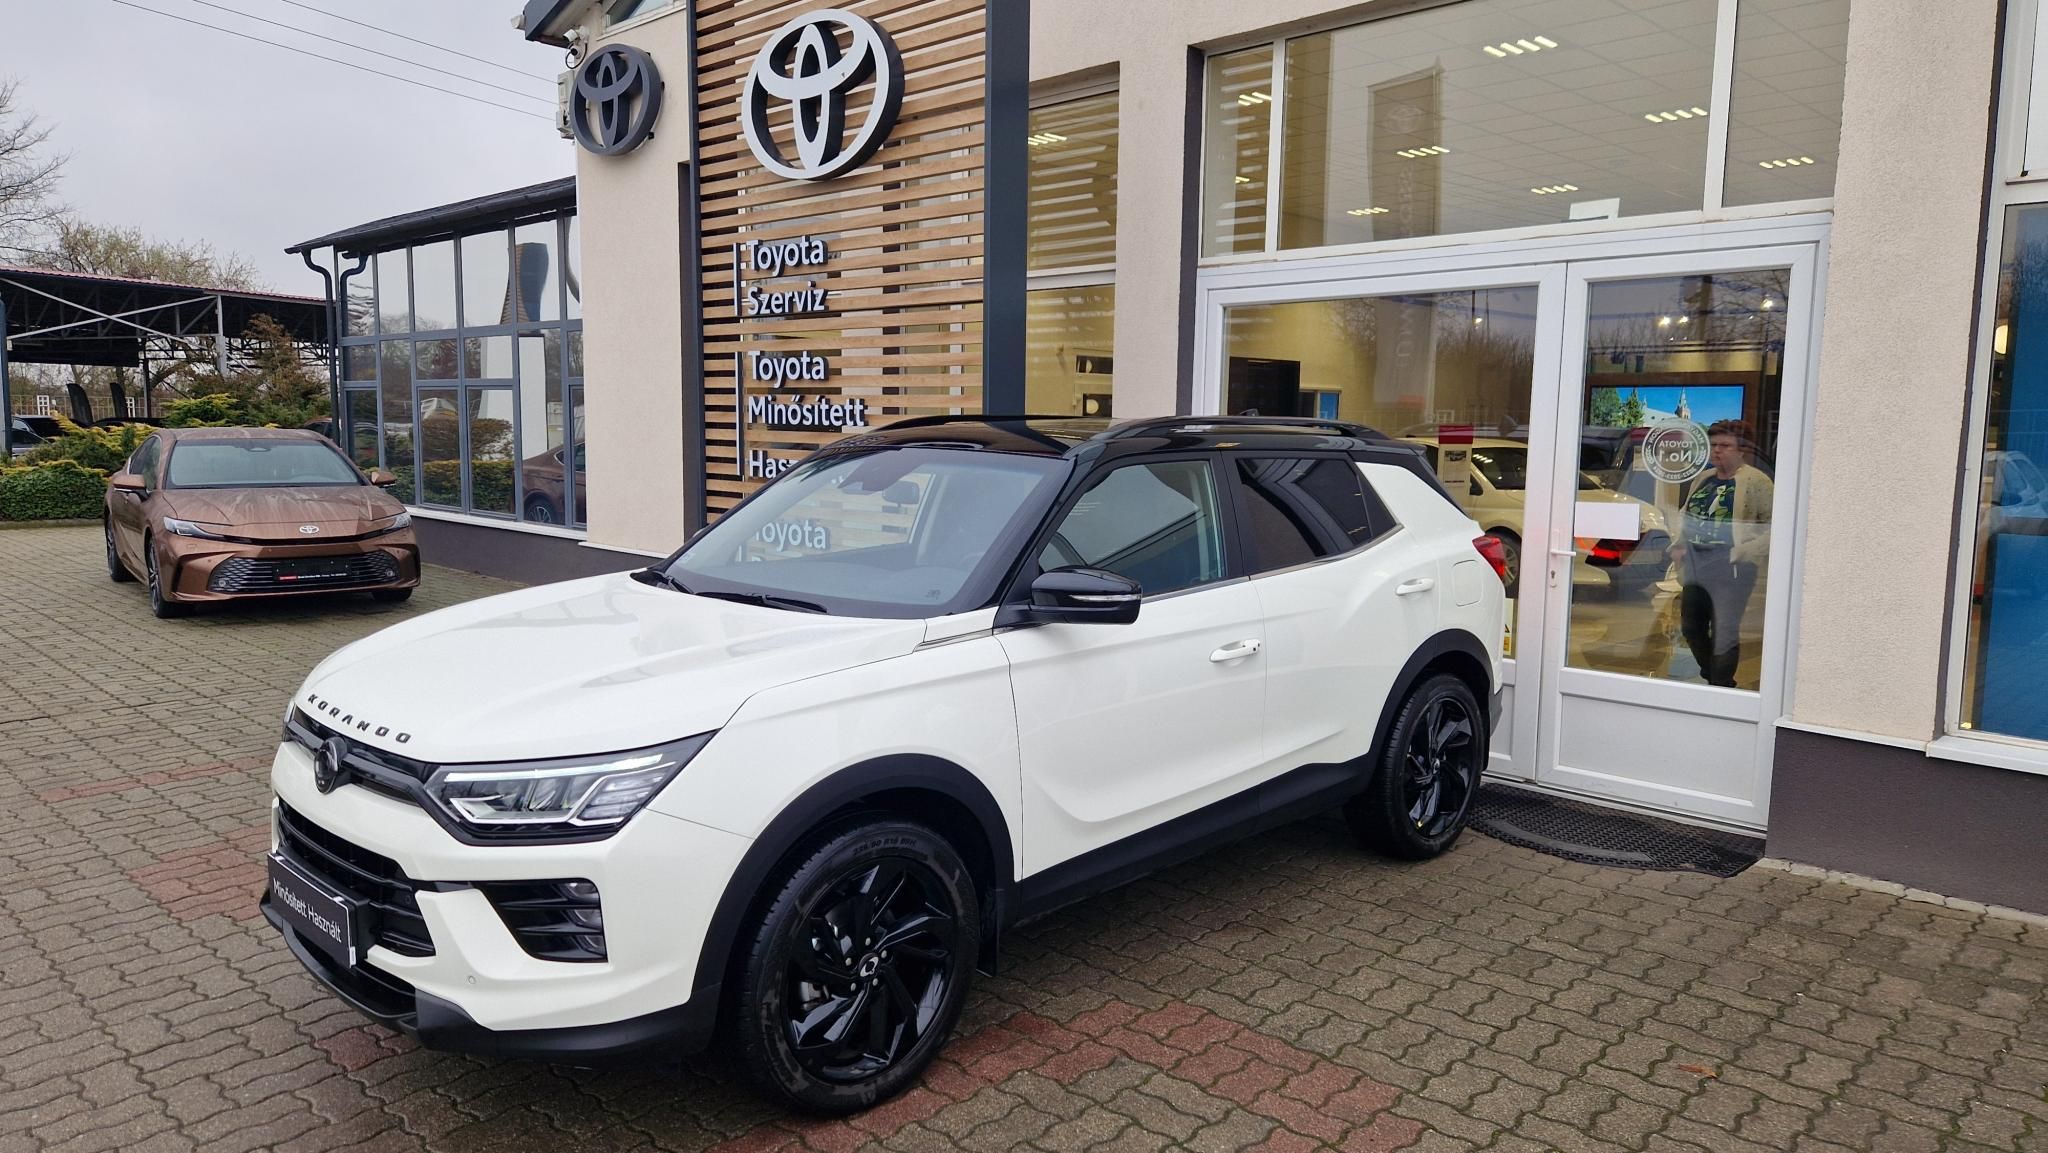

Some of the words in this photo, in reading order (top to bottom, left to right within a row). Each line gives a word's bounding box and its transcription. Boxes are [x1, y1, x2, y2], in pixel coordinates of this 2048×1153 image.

[746, 236, 826, 277] Toyota
[748, 280, 827, 315] Szerviz
[748, 350, 826, 389] Toyota
[748, 394, 866, 427] Minősített
[755, 519, 826, 552] oyota
[307, 693, 412, 744] KORANDO
[307, 903, 342, 943] Használt
